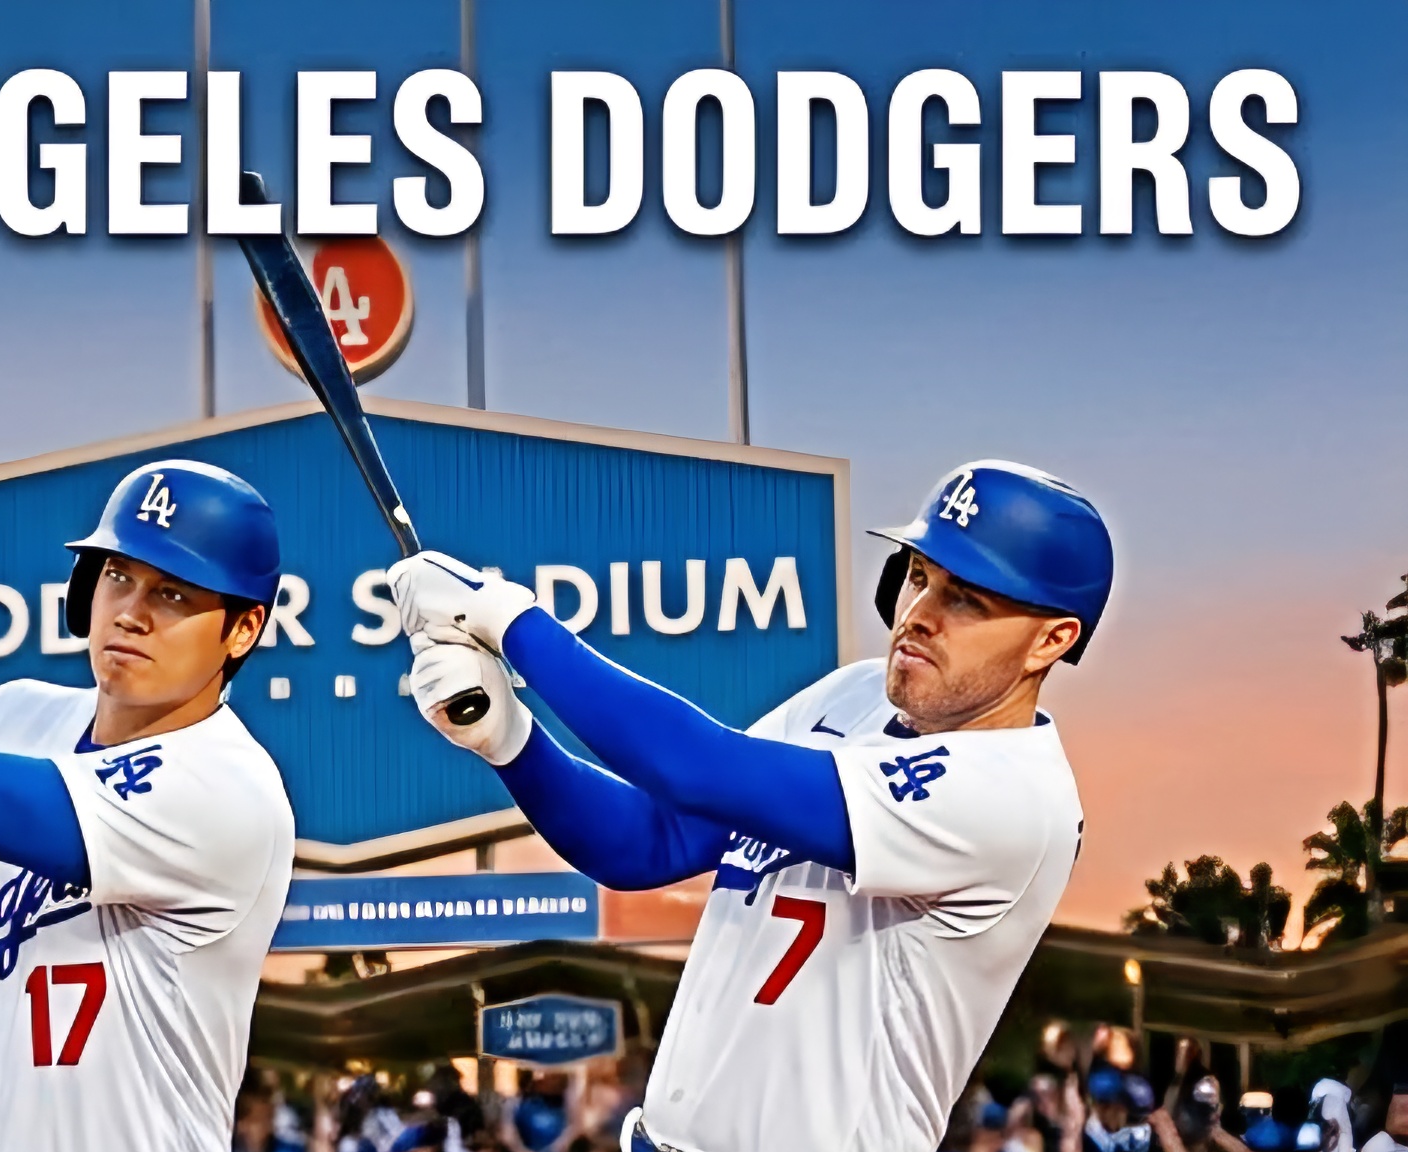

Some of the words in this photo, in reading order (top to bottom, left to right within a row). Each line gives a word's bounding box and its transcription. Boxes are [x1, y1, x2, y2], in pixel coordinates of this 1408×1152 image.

[351, 556, 807, 646] SDIUM
[753, 894, 826, 1006] 7
[25, 961, 106, 1067] 17
